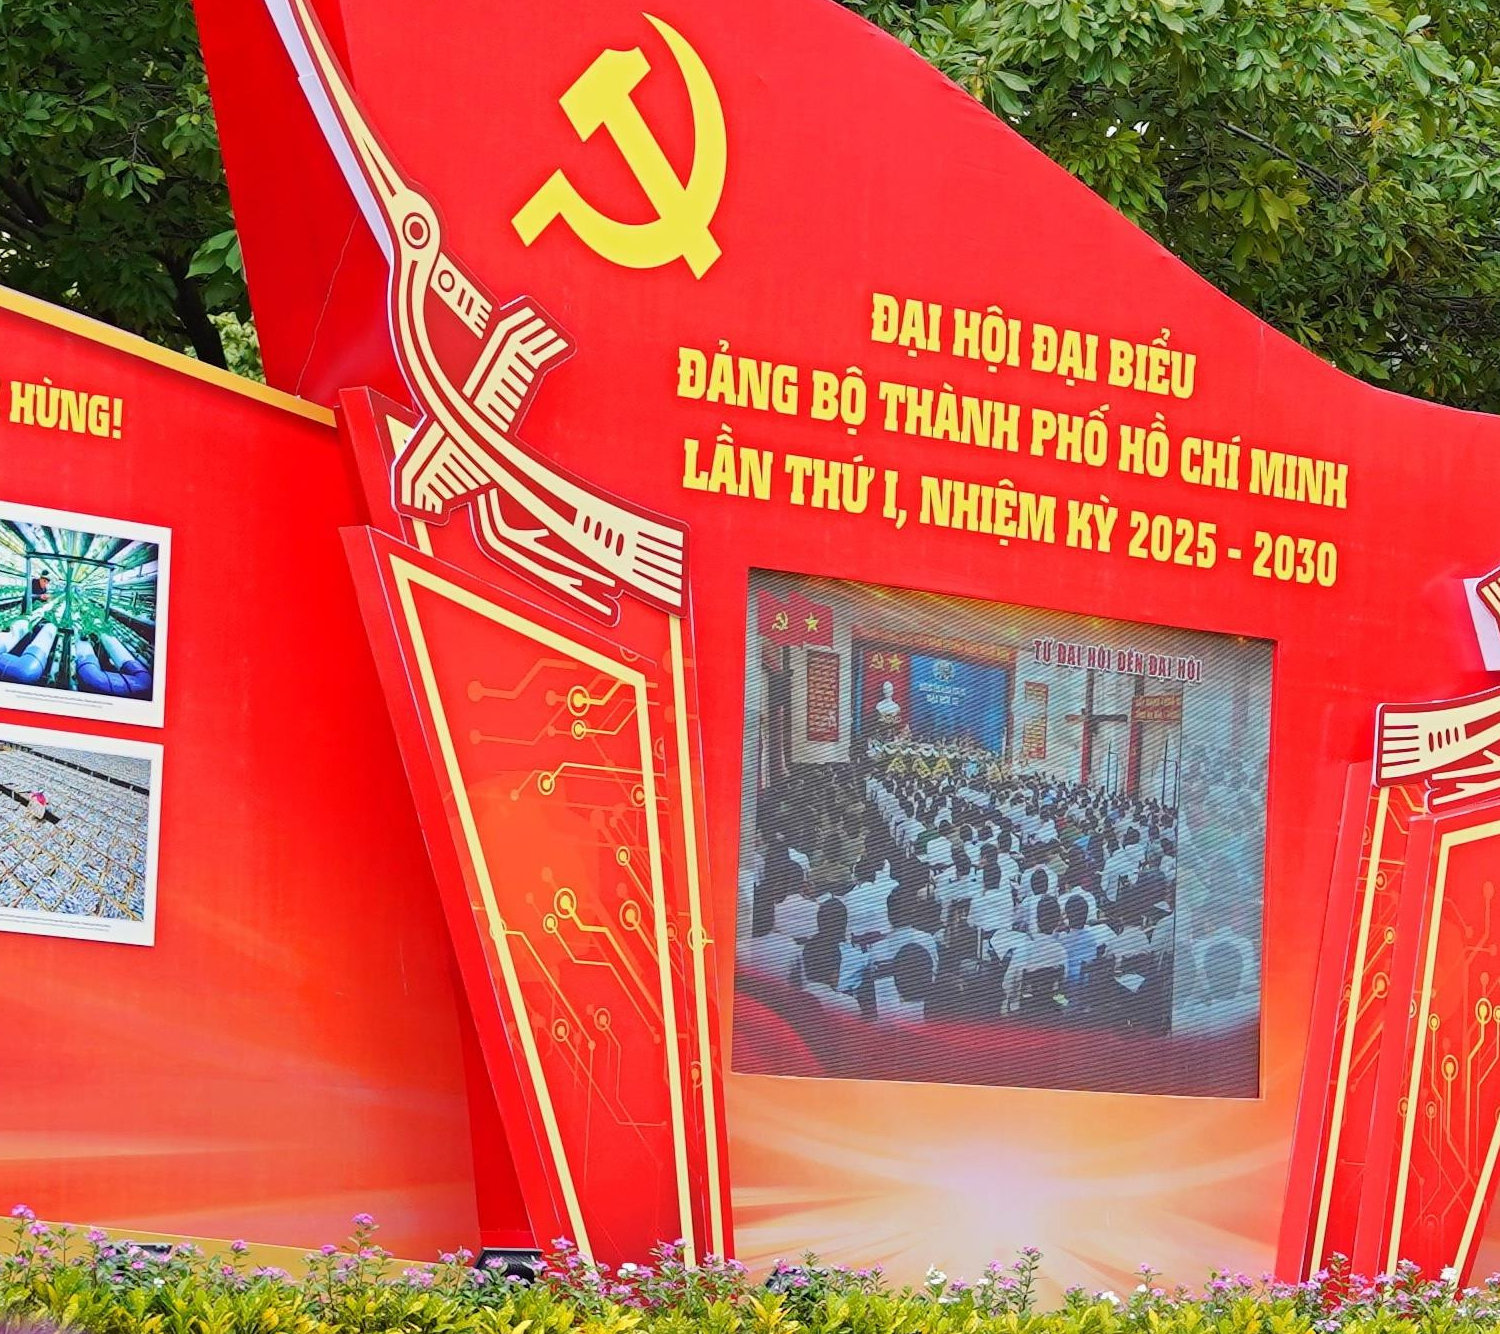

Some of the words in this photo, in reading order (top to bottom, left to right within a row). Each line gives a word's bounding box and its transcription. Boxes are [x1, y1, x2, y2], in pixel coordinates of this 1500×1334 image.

[871, 291, 942, 358] ĐẠI
[952, 304, 1022, 373] HỘI
[1031, 322, 1099, 387] ĐẠI
[1107, 326, 1197, 399] BIỂU
[9, 376, 123, 439] HÙNG!
[677, 338, 799, 416] ĐẢNG
[810, 365, 867, 436] BỘ
[878, 380, 1021, 453] THÀNH
[1030, 402, 1110, 467] PHỐ
[1118, 410, 1170, 478] HỒ
[1180, 434, 1241, 491] CHÍ
[1249, 447, 1349, 509] MINH
[682, 422, 774, 501] LẦN
[784, 453, 876, 514] THỨ
[882, 468, 907, 530] I,
[919, 474, 1057, 546] NHIỆM
[1066, 493, 1119, 553] KỲ
[1128, 509, 1217, 569] 2025
[1252, 529, 1338, 587] 2030
[1056, 642, 1083, 672] ĐẠI
[1087, 644, 1112, 675] HỘI
[1116, 647, 1146, 676] ĐẾN
[1148, 653, 1173, 682] ĐẠI
[1176, 655, 1203, 687] HỘI
